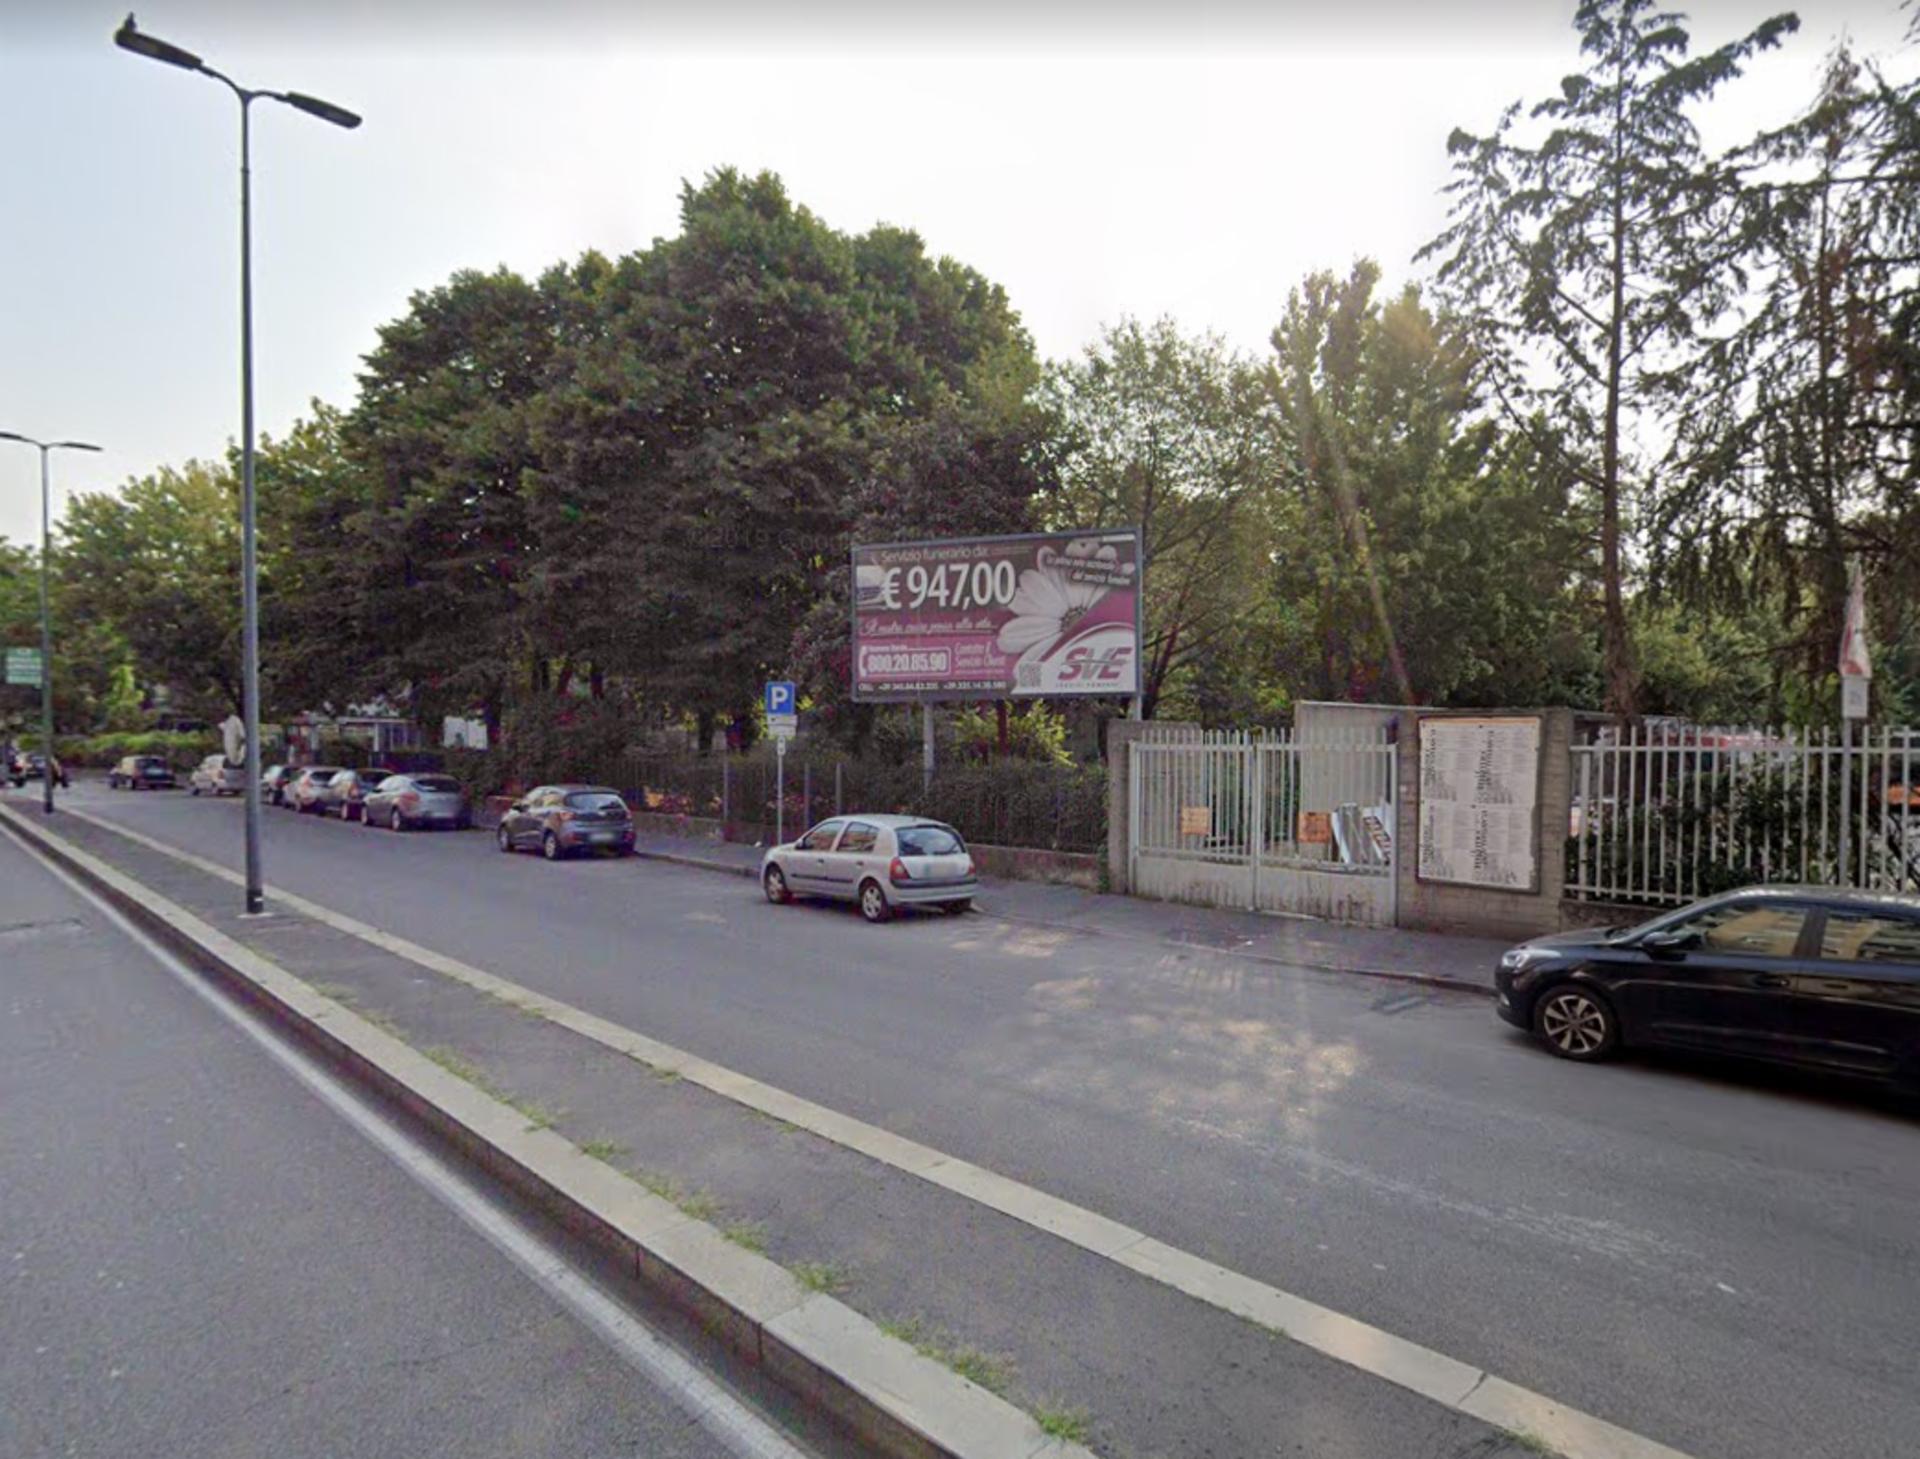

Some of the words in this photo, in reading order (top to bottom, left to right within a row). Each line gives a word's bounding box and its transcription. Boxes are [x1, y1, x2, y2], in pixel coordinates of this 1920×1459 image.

[907, 560, 1016, 610] 947,00
[1058, 646, 1133, 681] SVE
[771, 686, 788, 710] P
